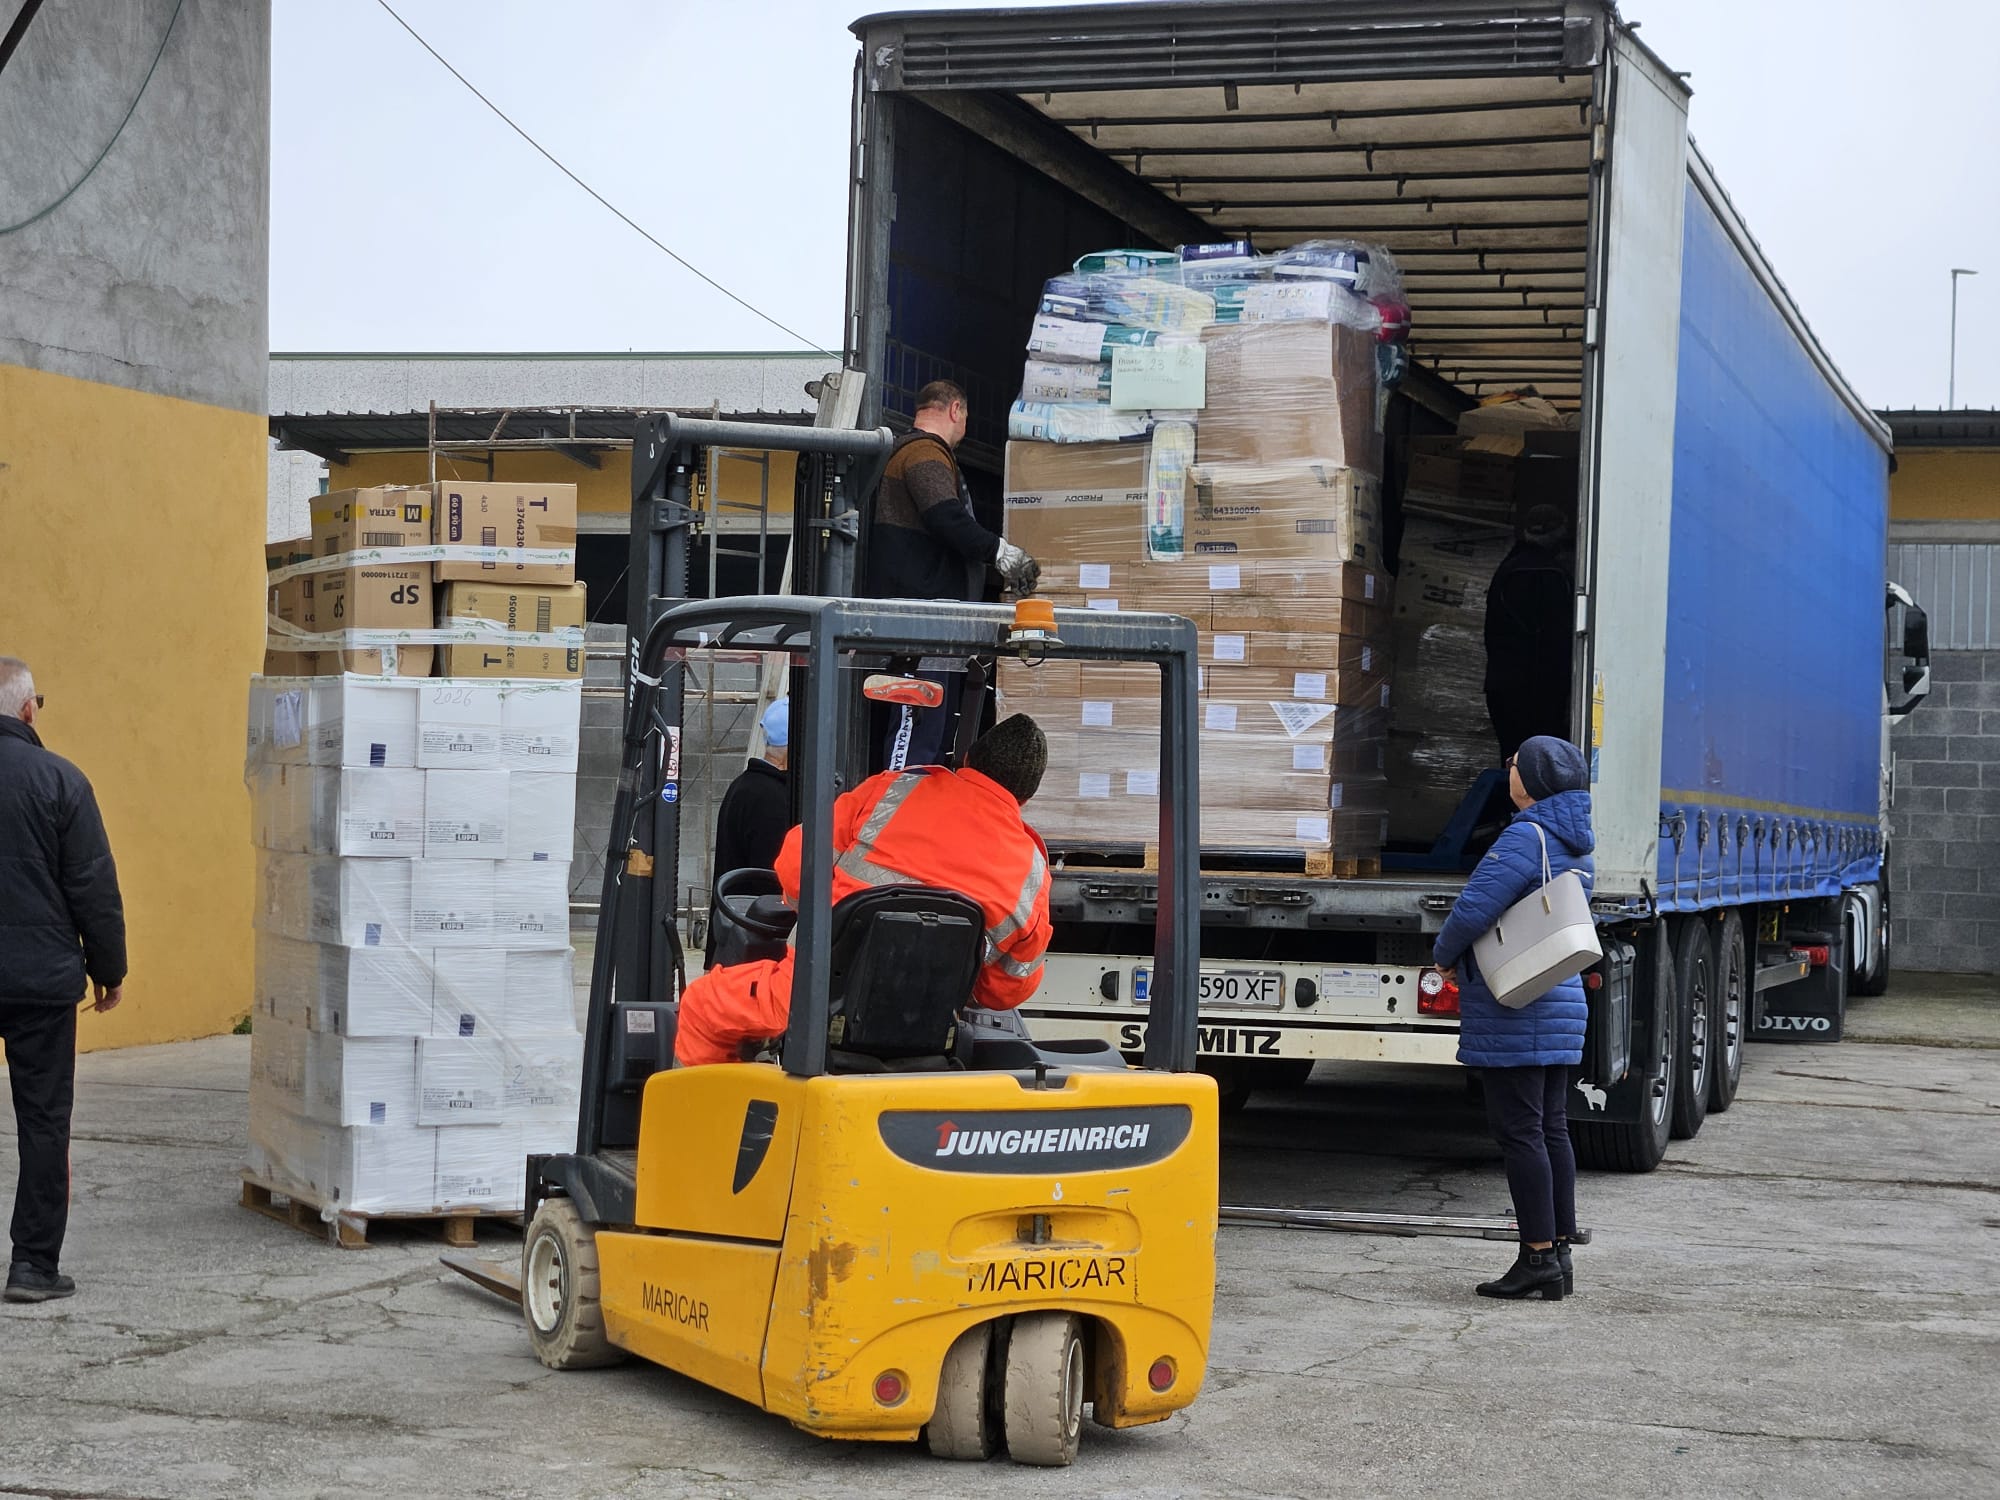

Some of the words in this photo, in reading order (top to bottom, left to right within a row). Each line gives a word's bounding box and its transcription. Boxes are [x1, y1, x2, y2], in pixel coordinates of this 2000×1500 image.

[451, 497, 459, 508] 60
[529, 496, 548, 512] T
[1006, 496, 1043, 504] FREDDY
[1064, 494, 1103, 503] FREDDY
[368, 508, 396, 517] EXTRA
[407, 507, 420, 521] M
[451, 526, 458, 538] cm
[516, 507, 525, 570] 37642300
[390, 584, 420, 605] SP
[483, 652, 502, 668] T
[896, 732, 907, 751] NYC
[1136, 989, 1146, 997] UA
[1199, 977, 1239, 999] 590
[1245, 978, 1277, 1001] XF
[1759, 1015, 1831, 1031] OLVO
[1120, 1024, 1282, 1056] SMITZ
[936, 1123, 1151, 1157] JUNGHEINRICH
[967, 1257, 1127, 1293] MARICAR
[642, 1281, 710, 1333] MARICAR
